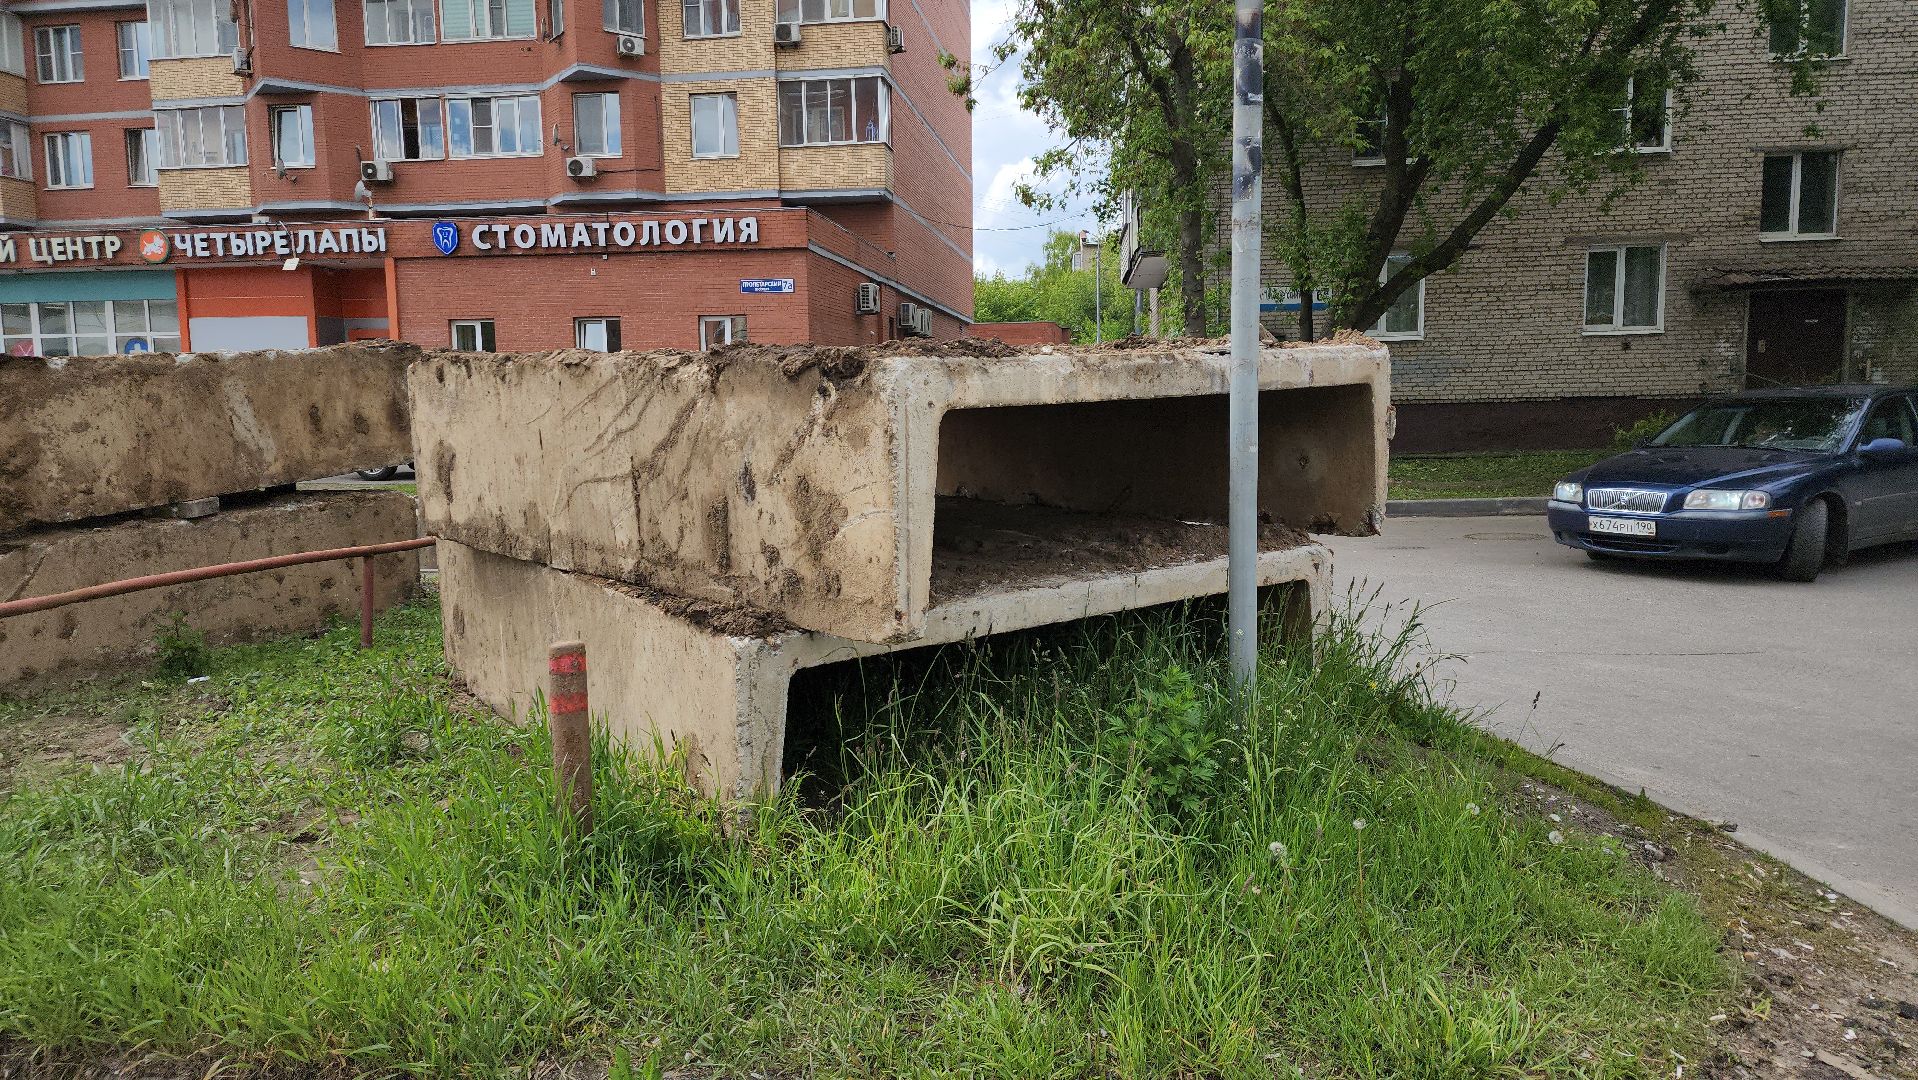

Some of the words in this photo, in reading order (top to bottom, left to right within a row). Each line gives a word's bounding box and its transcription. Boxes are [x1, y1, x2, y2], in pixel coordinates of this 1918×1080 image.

[174, 230, 290, 257] ЧЕТЫРЕ
[296, 227, 386, 254] ЛАПЫ
[472, 217, 758, 249] СТОМАТОЛОГИЯ
[28, 235, 121, 265] ЦЕНТР
[1636, 521, 1652, 530] 190
